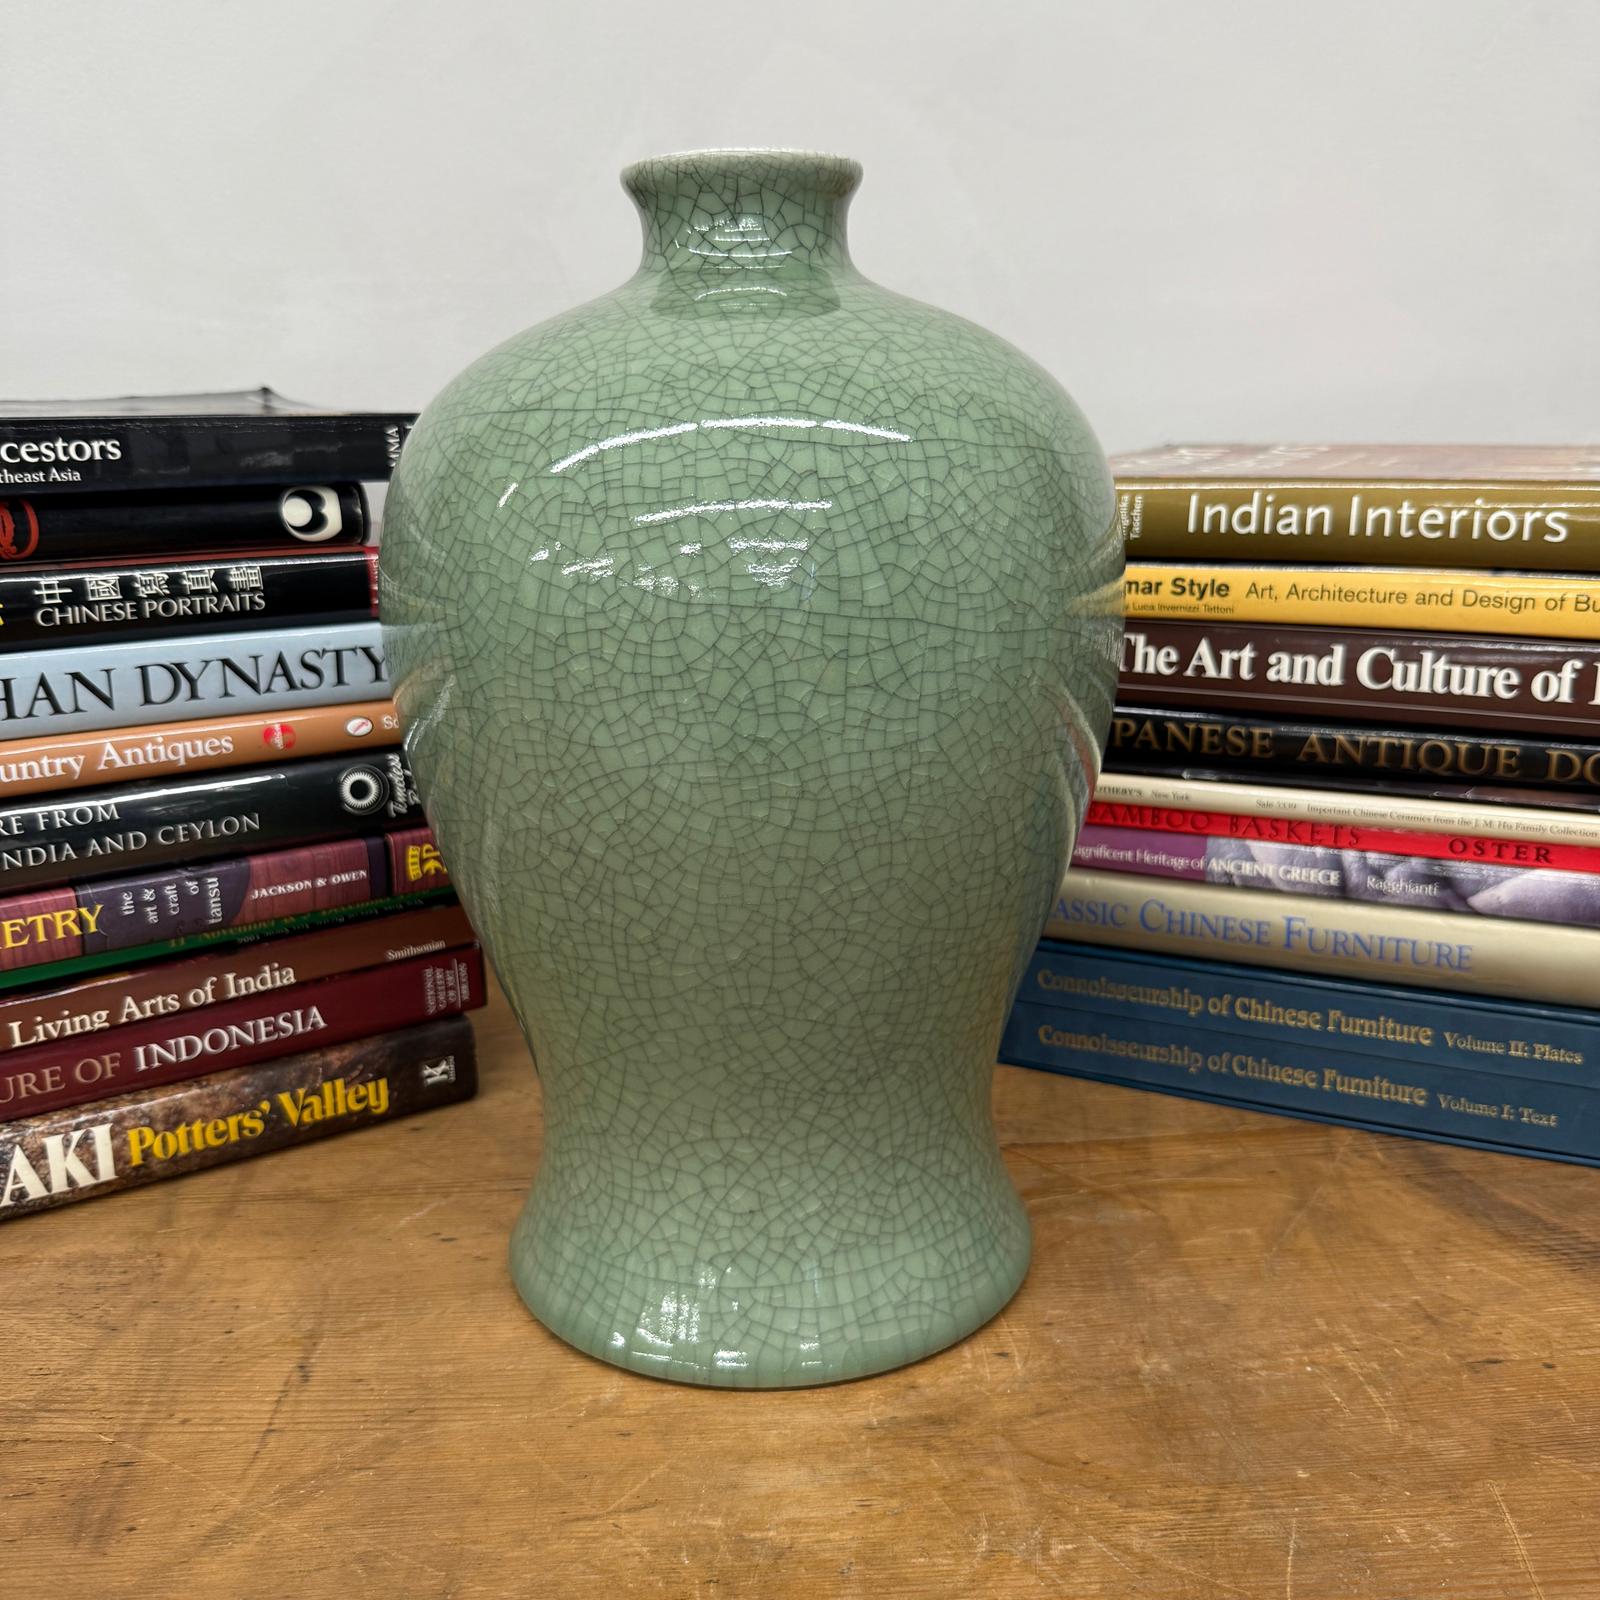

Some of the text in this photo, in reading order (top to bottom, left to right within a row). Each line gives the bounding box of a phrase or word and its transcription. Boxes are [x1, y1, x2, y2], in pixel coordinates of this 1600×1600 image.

[0, 436, 122, 463] cestors
[48, 466, 82, 482] Asia
[1130, 495, 1143, 540] Taschen
[1186, 490, 1569, 543] Indian Interiors
[36, 592, 266, 627] CHINESE PORTRAITS
[1132, 602, 1155, 612] Luca
[1203, 603, 1235, 615] Tettoni
[1170, 577, 1230, 600] Style
[1245, 581, 1279, 602] Art,
[1286, 582, 1408, 605] Architecture
[1415, 589, 1454, 607] and
[1462, 589, 1536, 615] Design
[1544, 592, 1568, 612] of
[134, 646, 389, 708] DYNASTY
[1119, 632, 1180, 676] The
[1183, 636, 1258, 681] Art
[1266, 643, 1347, 686] and
[1356, 645, 1522, 700] Culture
[1530, 658, 1585, 704] of
[0, 754, 86, 783] untry
[97, 734, 235, 771] Antiques
[1112, 717, 1276, 759] PANESE
[1297, 732, 1522, 778] ANTIQUE
[36, 801, 121, 832] FROM
[1088, 801, 1553, 865] BAMBOO BASKETS OSTER
[1307, 803, 1350, 817] Important
[1353, 807, 1388, 820] Chinese
[1390, 810, 1432, 823] Ceramics
[1433, 814, 1455, 825] from
[1457, 816, 1472, 826] the
[1515, 822, 1547, 834] Family
[1550, 824, 1600, 838] Collection
[2, 811, 261, 872] NDIA AND CEYLON
[185, 880, 201, 896] of
[251, 869, 368, 900] JACKSON & OWEN
[1136, 848, 1190, 871] Heritage
[1190, 855, 1207, 870] of
[1208, 857, 1276, 879] ANCIENT
[1279, 865, 1342, 886] GREECE
[1366, 875, 1441, 897] Ragghianti
[121, 891, 136, 916] the
[144, 904, 160, 924] art
[164, 882, 181, 916] craft
[206, 877, 224, 925] tansu
[1, 904, 104, 949] ETRY
[1139, 898, 1272, 945] CHINESE
[1282, 915, 1474, 971] FURNITURE
[385, 939, 446, 961] Smithsonian
[8, 962, 297, 1048] Living Arts of India
[1037, 969, 1203, 1018] Connoisseurship
[1207, 993, 1232, 1016] of
[1234, 996, 1323, 1032] Chinese
[1328, 1009, 1436, 1047] Furniture
[1443, 1031, 1505, 1055] Volume
[1532, 1042, 1585, 1066] Plates
[74, 1052, 122, 1083] OF
[134, 1005, 328, 1073] INDONESIA
[1037, 1024, 1203, 1074] Connoisseurship
[1207, 1051, 1231, 1074] of
[1232, 1054, 1319, 1089] Chinese
[1323, 1067, 1430, 1107] Furniture
[1437, 1092, 1498, 1118] Volume
[1519, 1105, 1560, 1129] Text
[0, 1077, 390, 1206] AKI Potters' Valley
